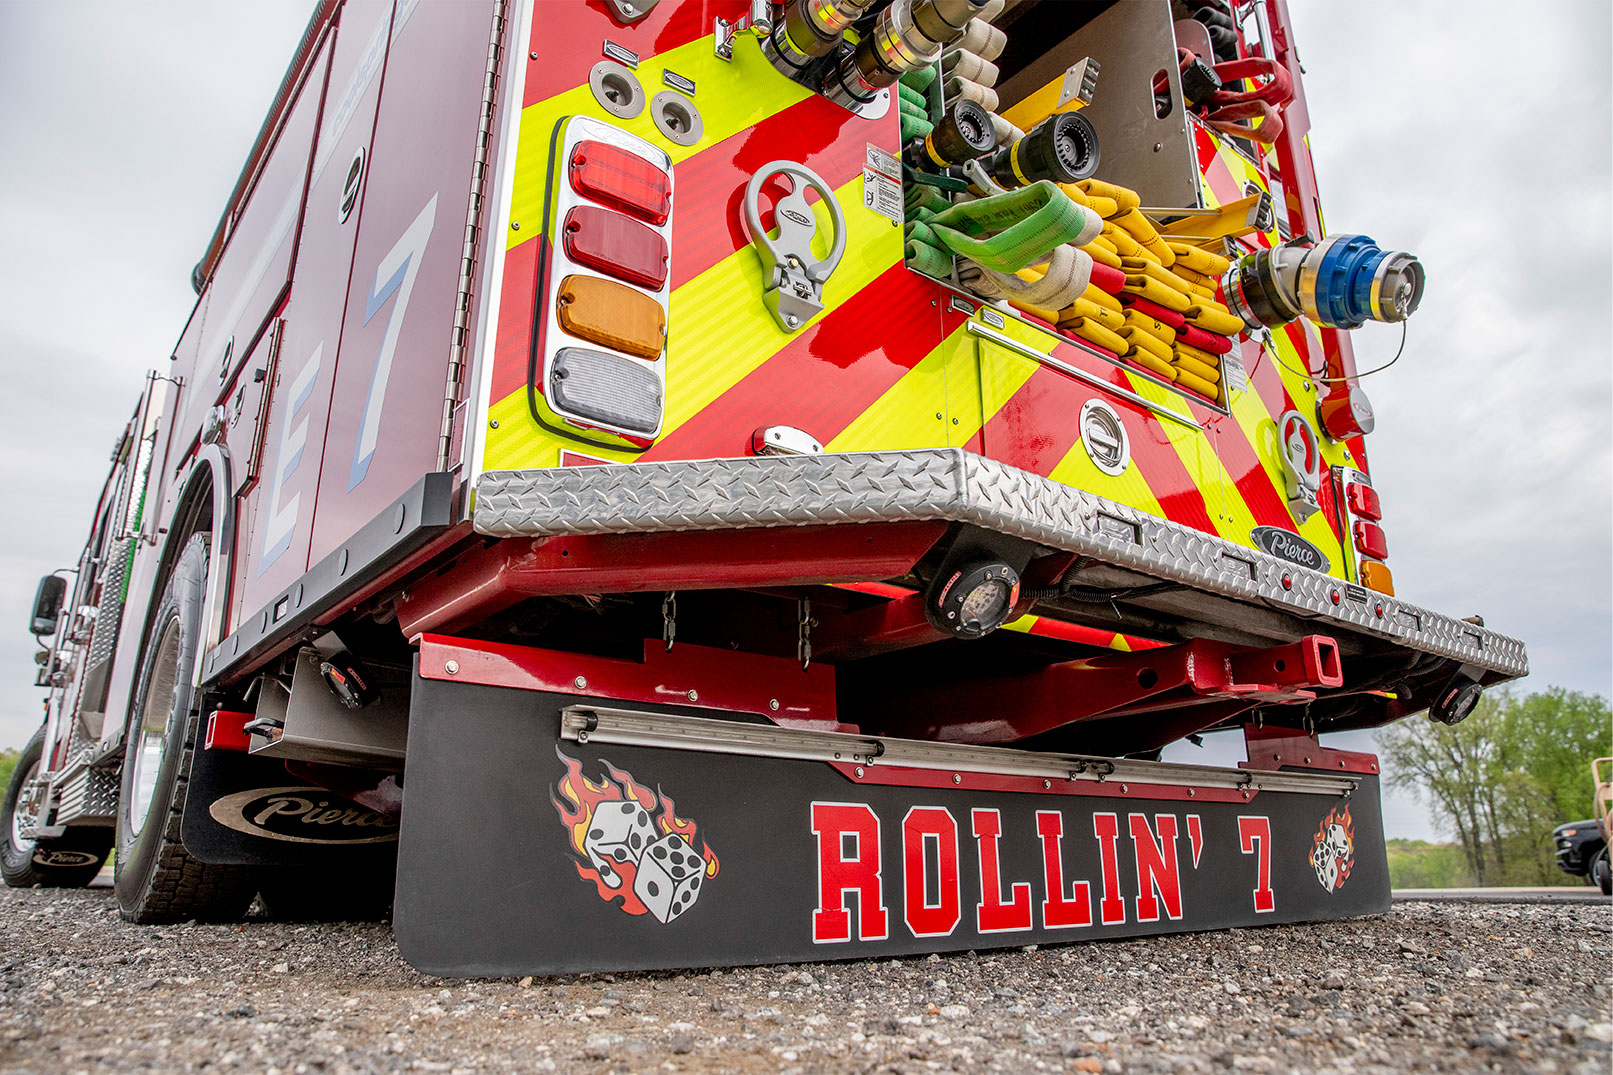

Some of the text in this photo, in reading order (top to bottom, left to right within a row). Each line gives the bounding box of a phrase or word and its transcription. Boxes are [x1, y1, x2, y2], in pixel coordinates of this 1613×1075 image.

[1270, 531, 1315, 566] Pierce
[810, 801, 1275, 944] ROLLIN' 7
